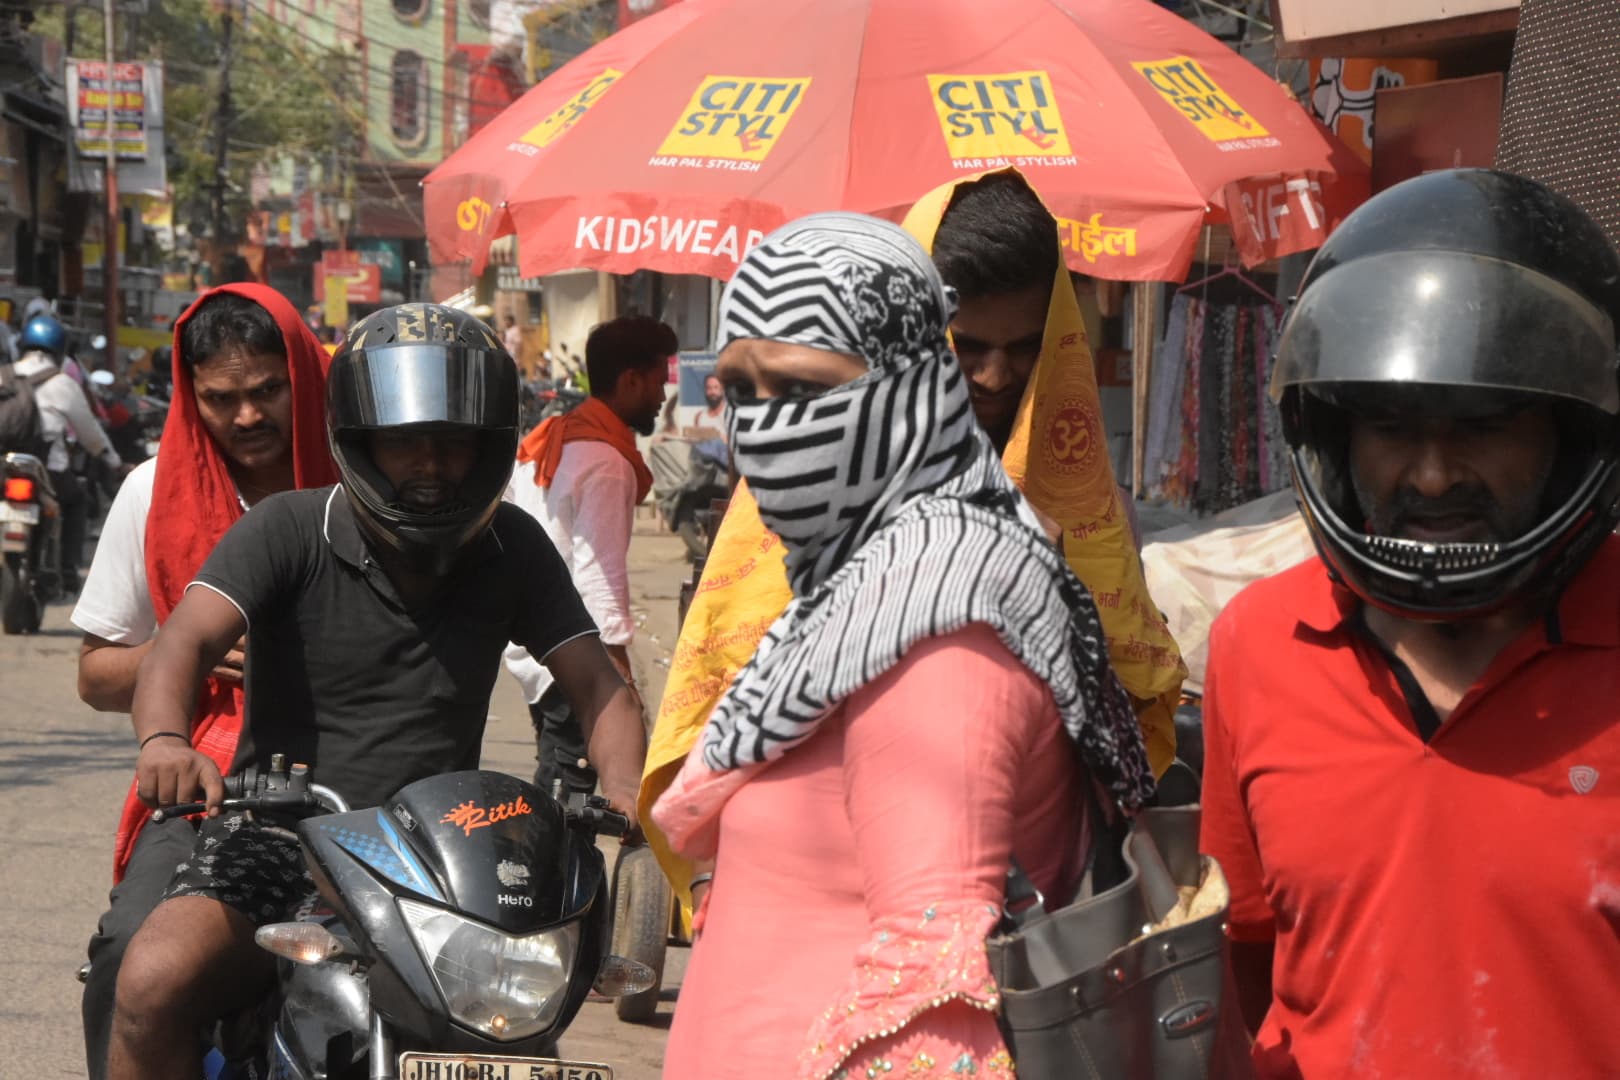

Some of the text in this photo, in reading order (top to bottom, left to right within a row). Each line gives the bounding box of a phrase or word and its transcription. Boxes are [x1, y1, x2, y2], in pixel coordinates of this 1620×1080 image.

[938, 76, 1048, 111] CITI
[1143, 60, 1217, 97] CITI
[700, 81, 802, 114] CITI
[648, 156, 761, 172] HAR PAL STYLISH
[952, 156, 1078, 169] HAR PAL STYLISH
[440, 796, 532, 837] Ritik
[497, 893, 533, 908] Hero
